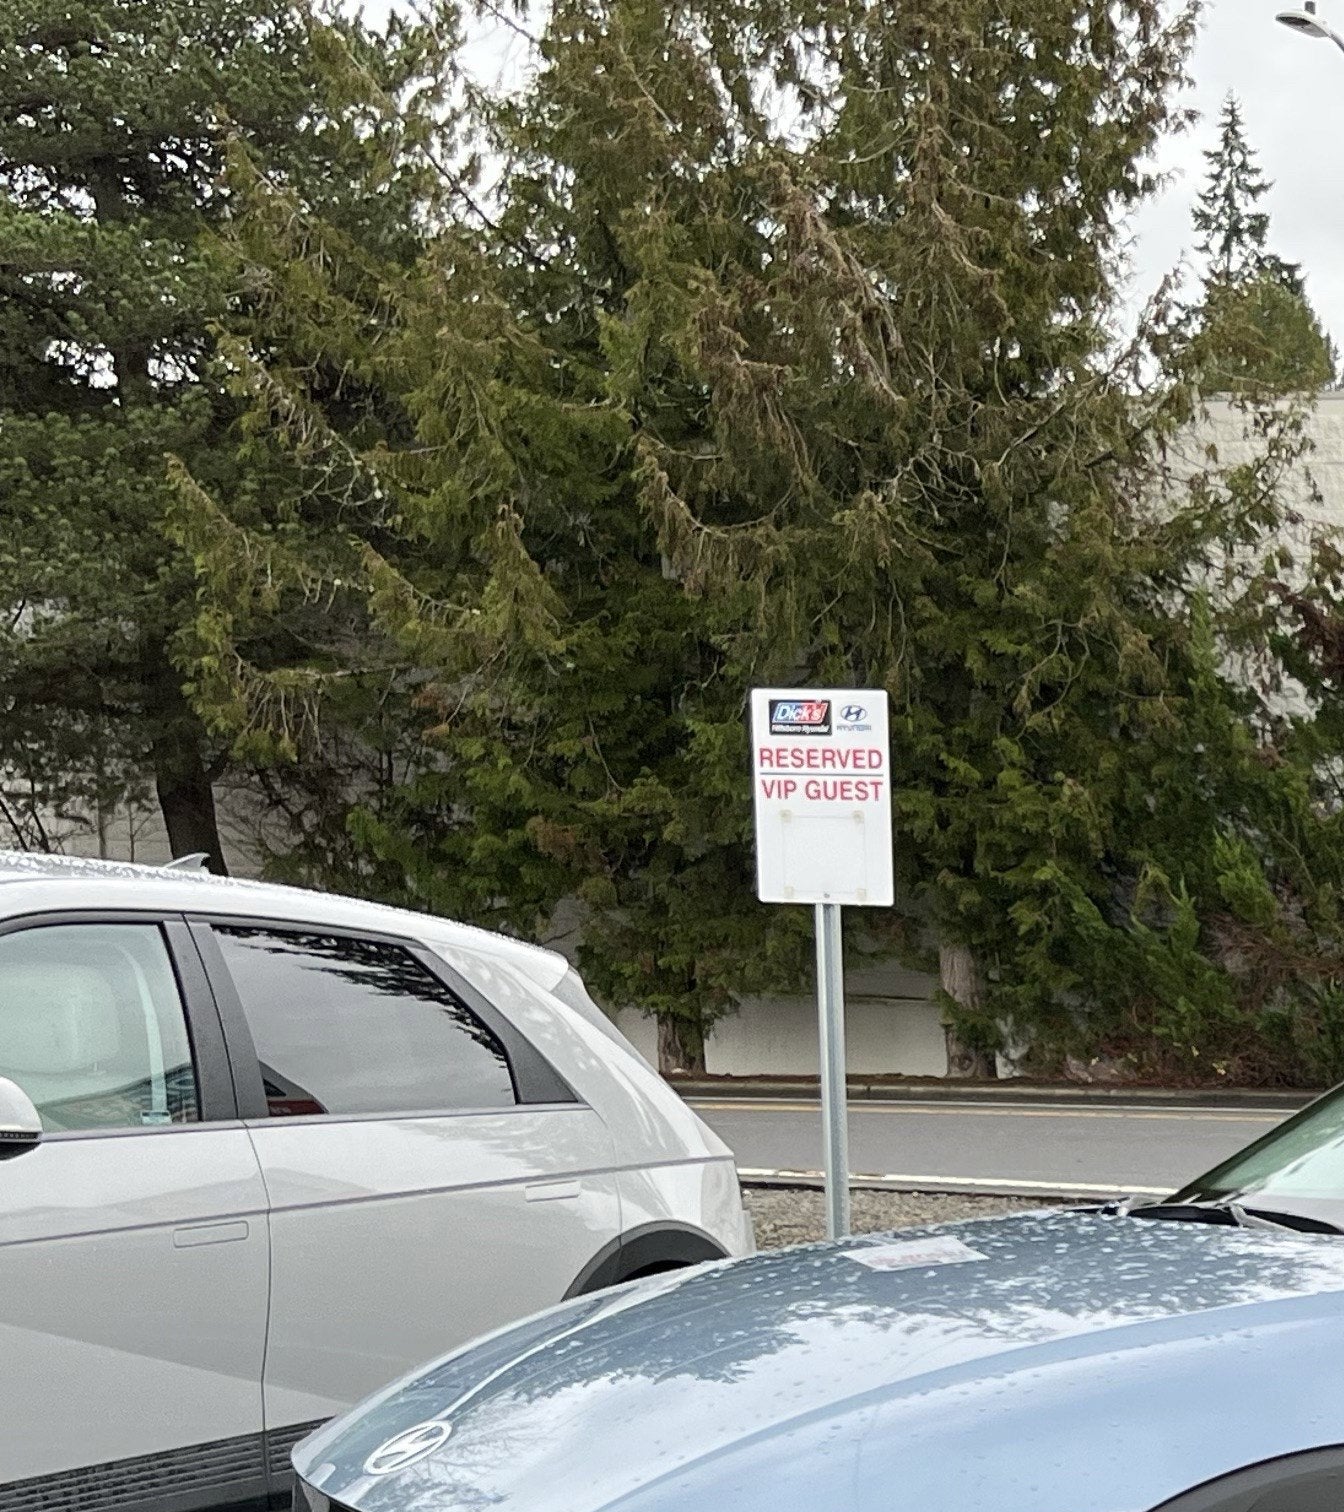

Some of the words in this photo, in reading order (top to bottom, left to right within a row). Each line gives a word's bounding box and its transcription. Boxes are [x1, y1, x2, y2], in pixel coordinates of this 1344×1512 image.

[759, 748, 883, 769] RESERVED
[761, 779, 797, 800] VIP
[804, 780, 884, 801] GUEST
